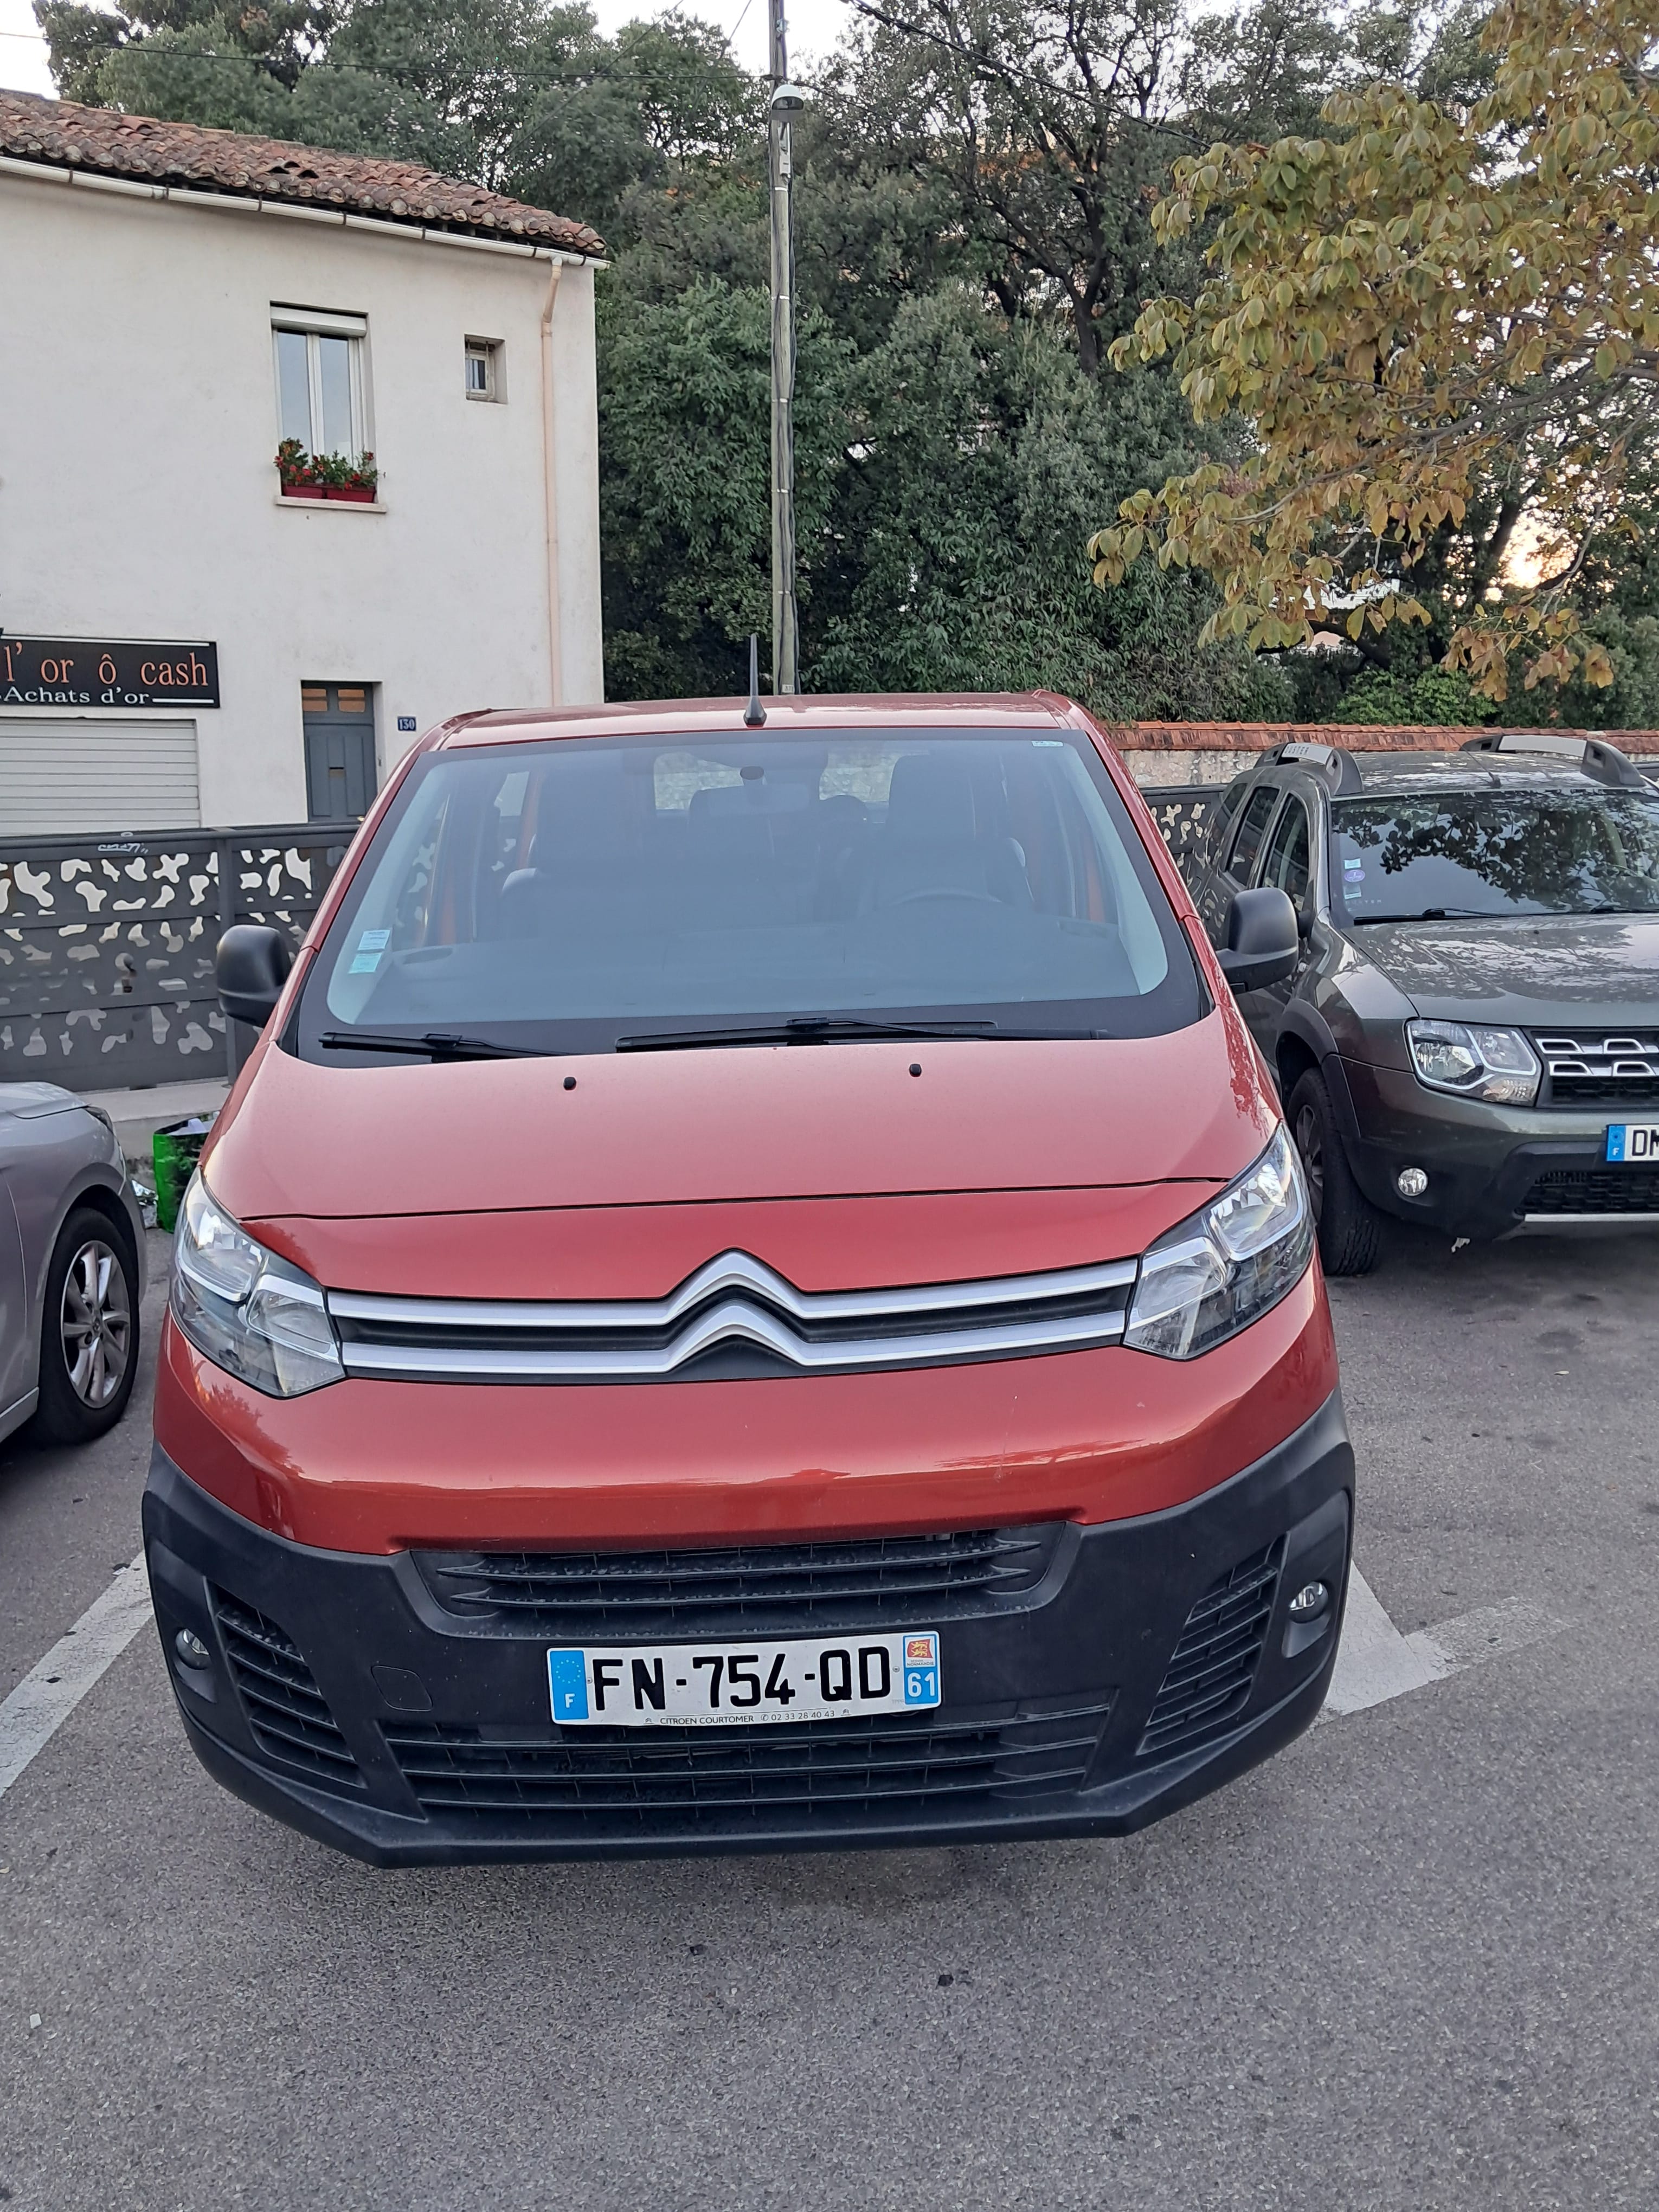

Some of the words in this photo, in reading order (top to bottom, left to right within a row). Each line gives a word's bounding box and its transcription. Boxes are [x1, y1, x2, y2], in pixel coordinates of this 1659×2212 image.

[41, 658, 74, 684] or
[99, 653, 117, 685] ô
[140, 652, 209, 686] cash
[3, 686, 90, 704] Achats
[101, 687, 149, 704] d'or
[399, 718, 415, 730] 130
[1612, 1147, 1619, 1156] F
[593, 1647, 891, 1711] FN-754-QD
[908, 1671, 935, 1697] 61
[565, 1693, 575, 1707] F
[699, 1715, 754, 1724] COURTOMER
